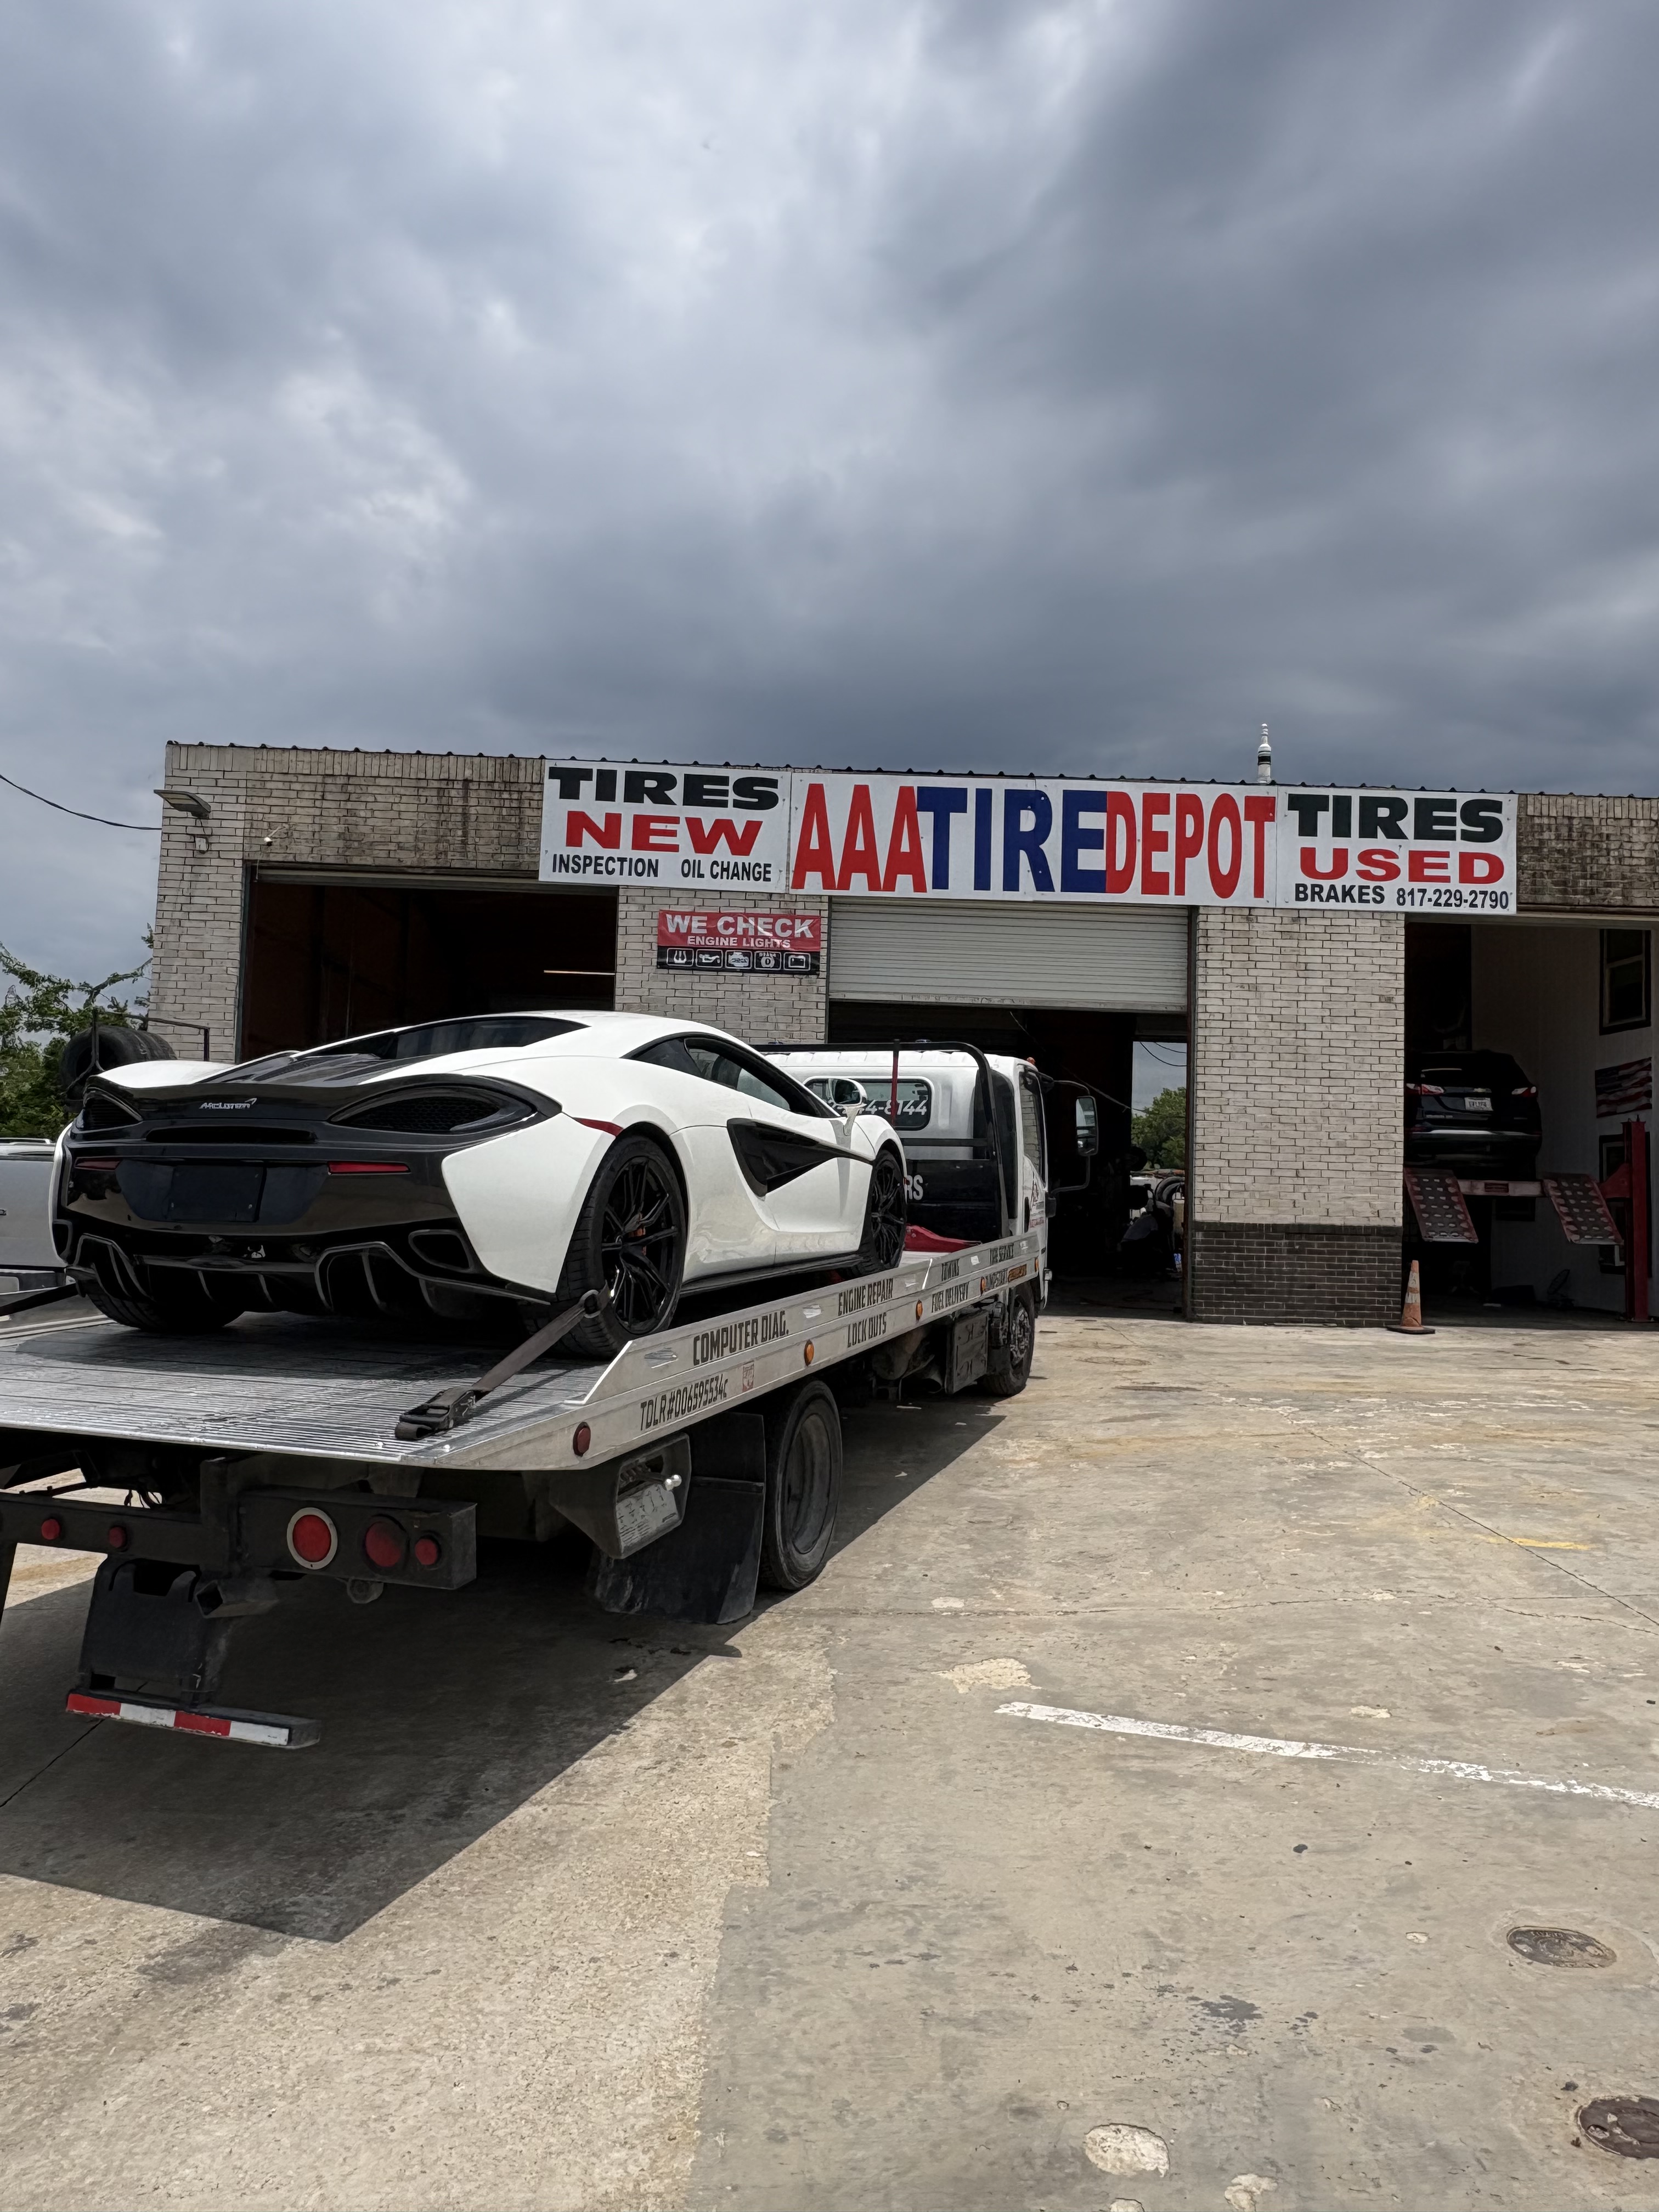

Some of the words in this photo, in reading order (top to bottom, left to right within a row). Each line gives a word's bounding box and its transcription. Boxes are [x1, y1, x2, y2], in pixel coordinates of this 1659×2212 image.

[548, 766, 779, 810] TIRES
[566, 810, 763, 856] NEW
[1287, 793, 1504, 843] TIRES
[552, 854, 659, 877] INSPECTION
[681, 859, 705, 879] OIL
[710, 861, 772, 882] CHANGE
[1300, 847, 1505, 884] USED
[1295, 883, 1385, 904] BRAKES
[1396, 887, 1509, 910] 817-229-2790
[665, 913, 708, 934] WE
[716, 916, 814, 939] CHECK
[687, 936, 738, 947] ENGINE
[742, 937, 791, 949] LIGHTS
[838, 1284, 866, 1317] ENGINE
[867, 1278, 894, 1306] REPAIR
[693, 1318, 758, 1366] COMPUTER
[761, 1310, 789, 1344] DIAG.
